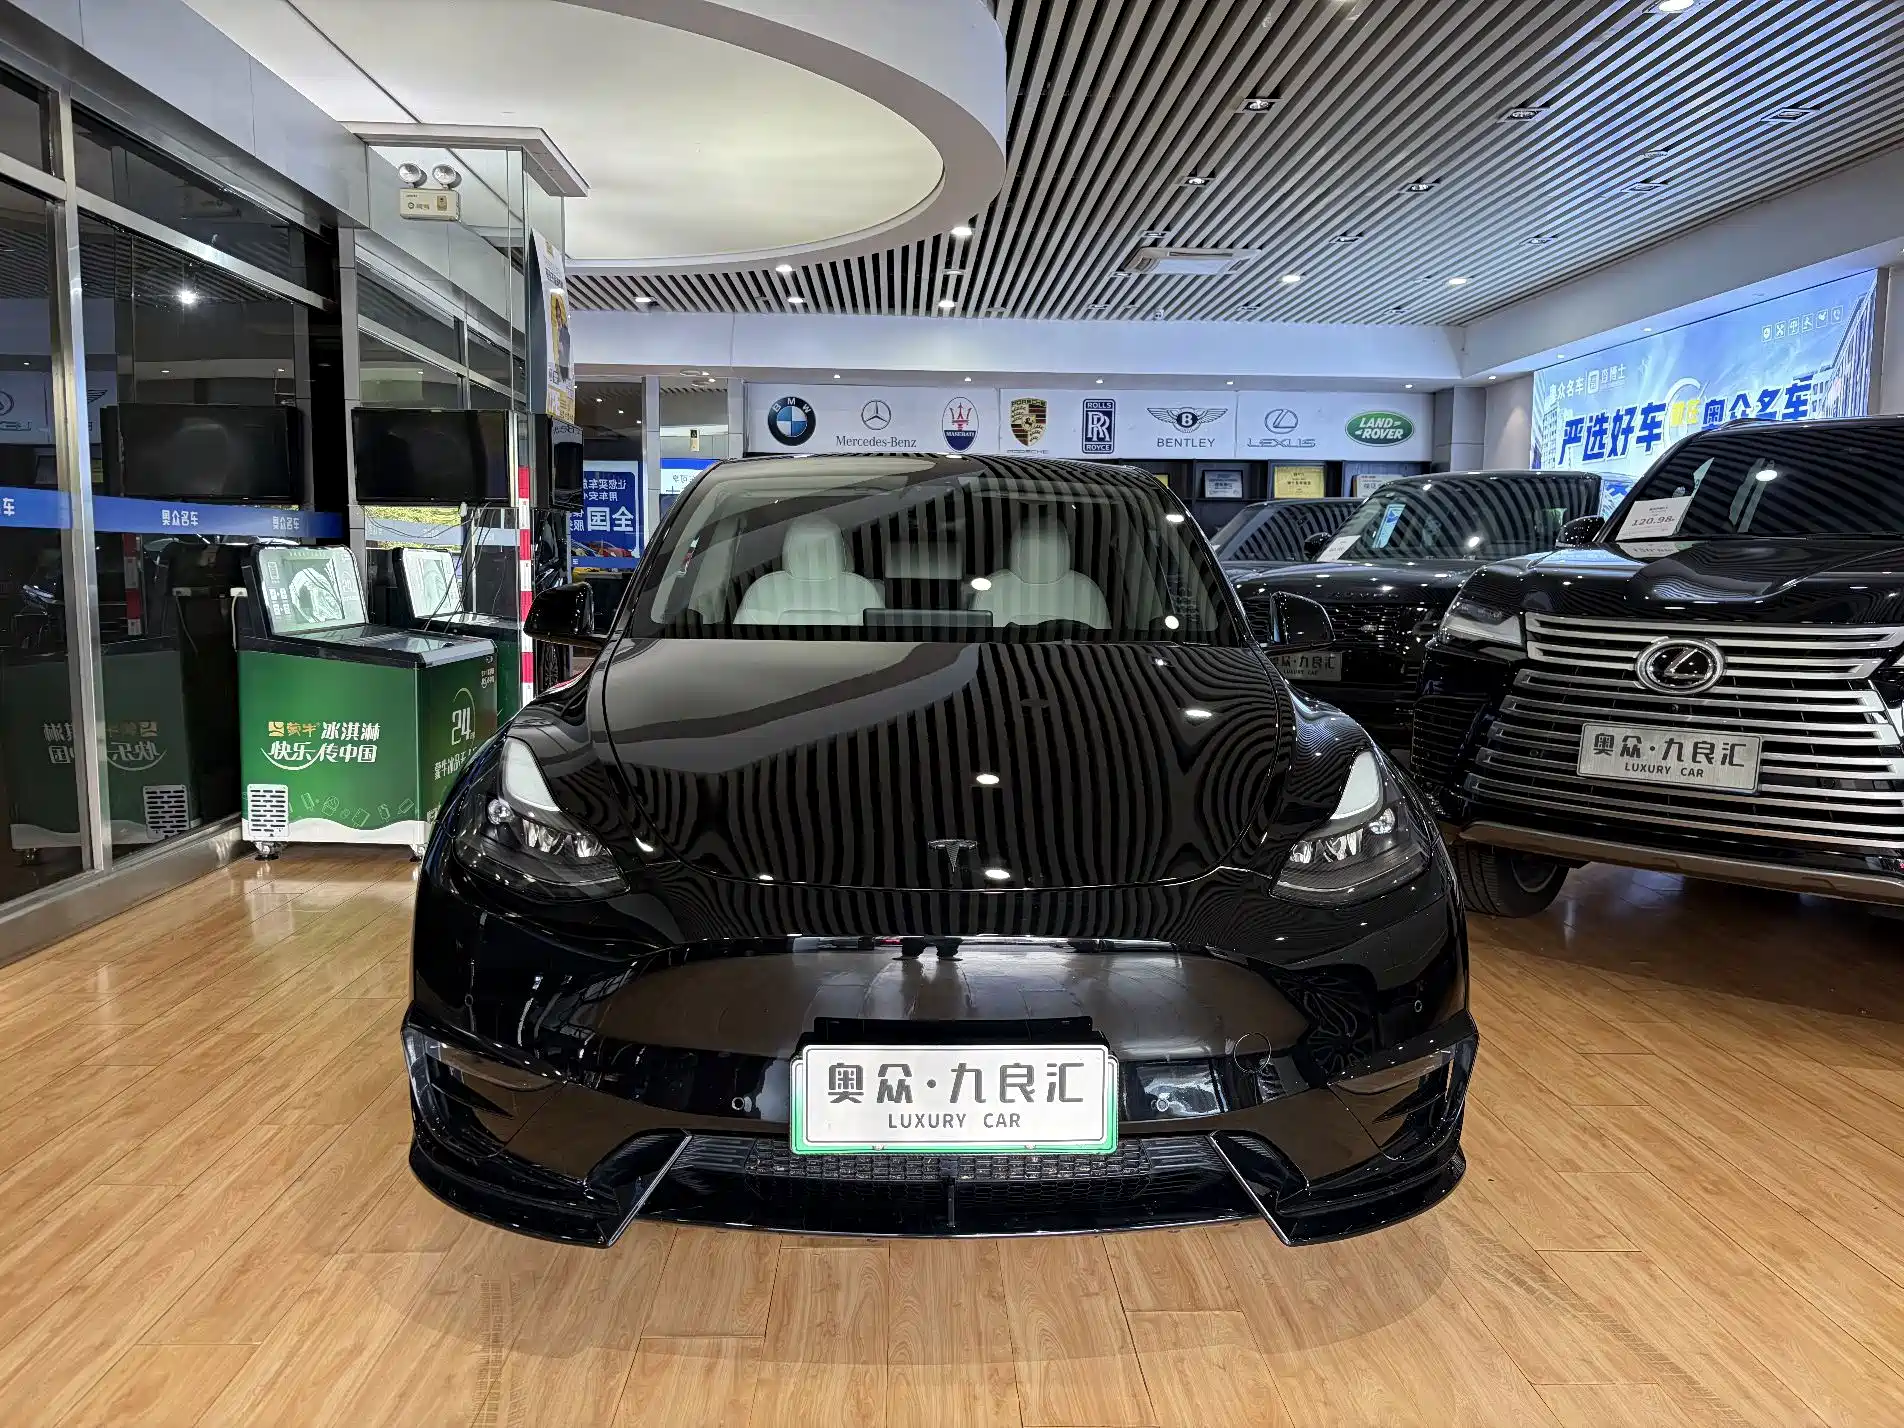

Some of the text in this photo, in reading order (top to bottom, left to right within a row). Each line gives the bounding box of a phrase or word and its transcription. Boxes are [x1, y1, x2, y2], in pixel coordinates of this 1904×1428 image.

[1359, 416, 1392, 429] LAND
[1363, 427, 1404, 440] ROVER
[1558, 402, 1666, 465] 严选好车
[836, 436, 916, 448] Mercedes-Benz
[1157, 438, 1215, 448] BENTLEY
[1247, 438, 1316, 448] LEXUS
[161, 509, 199, 526] 奥众名车
[321, 721, 380, 742] 冰淇淋
[451, 707, 472, 746] 24
[267, 741, 378, 765] 快乐传中国
[1624, 762, 1704, 778] LUXURY CAR
[888, 1112, 1021, 1129] LUXURY CAR
